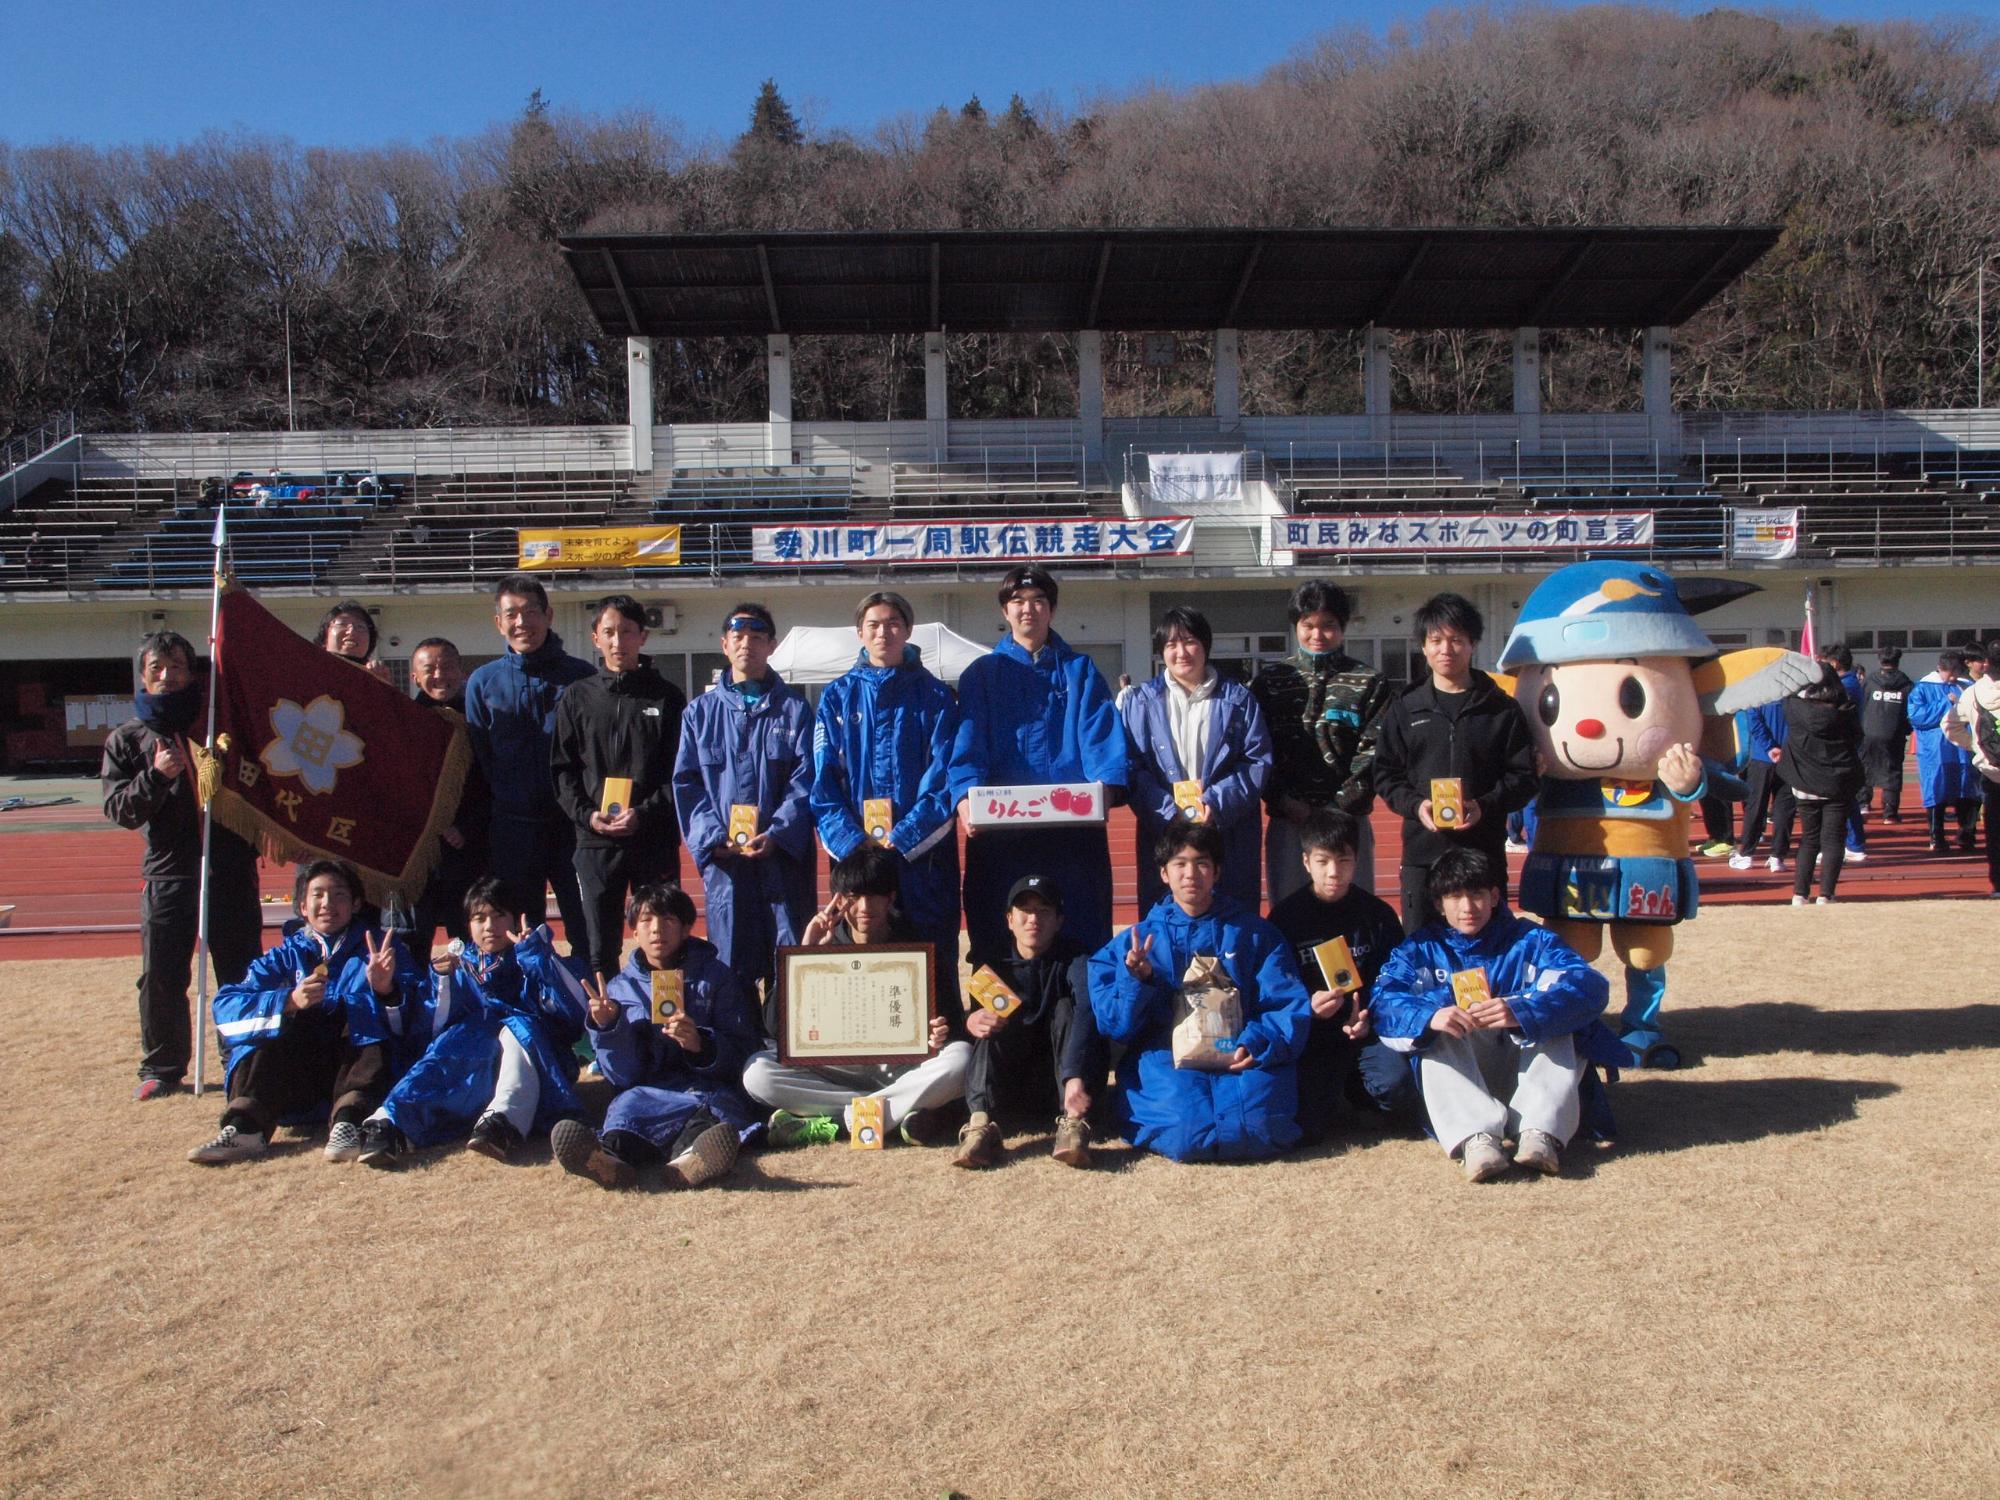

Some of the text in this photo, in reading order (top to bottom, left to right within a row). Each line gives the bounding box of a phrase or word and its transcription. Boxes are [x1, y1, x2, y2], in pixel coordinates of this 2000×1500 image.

[774, 522, 1177, 559] 愛川町一周駅伝競走大会
[1287, 518, 1637, 545] 町民みなスポーツの町宣言
[988, 796, 1048, 818] りんご
[889, 984, 903, 1029] 準優勝
